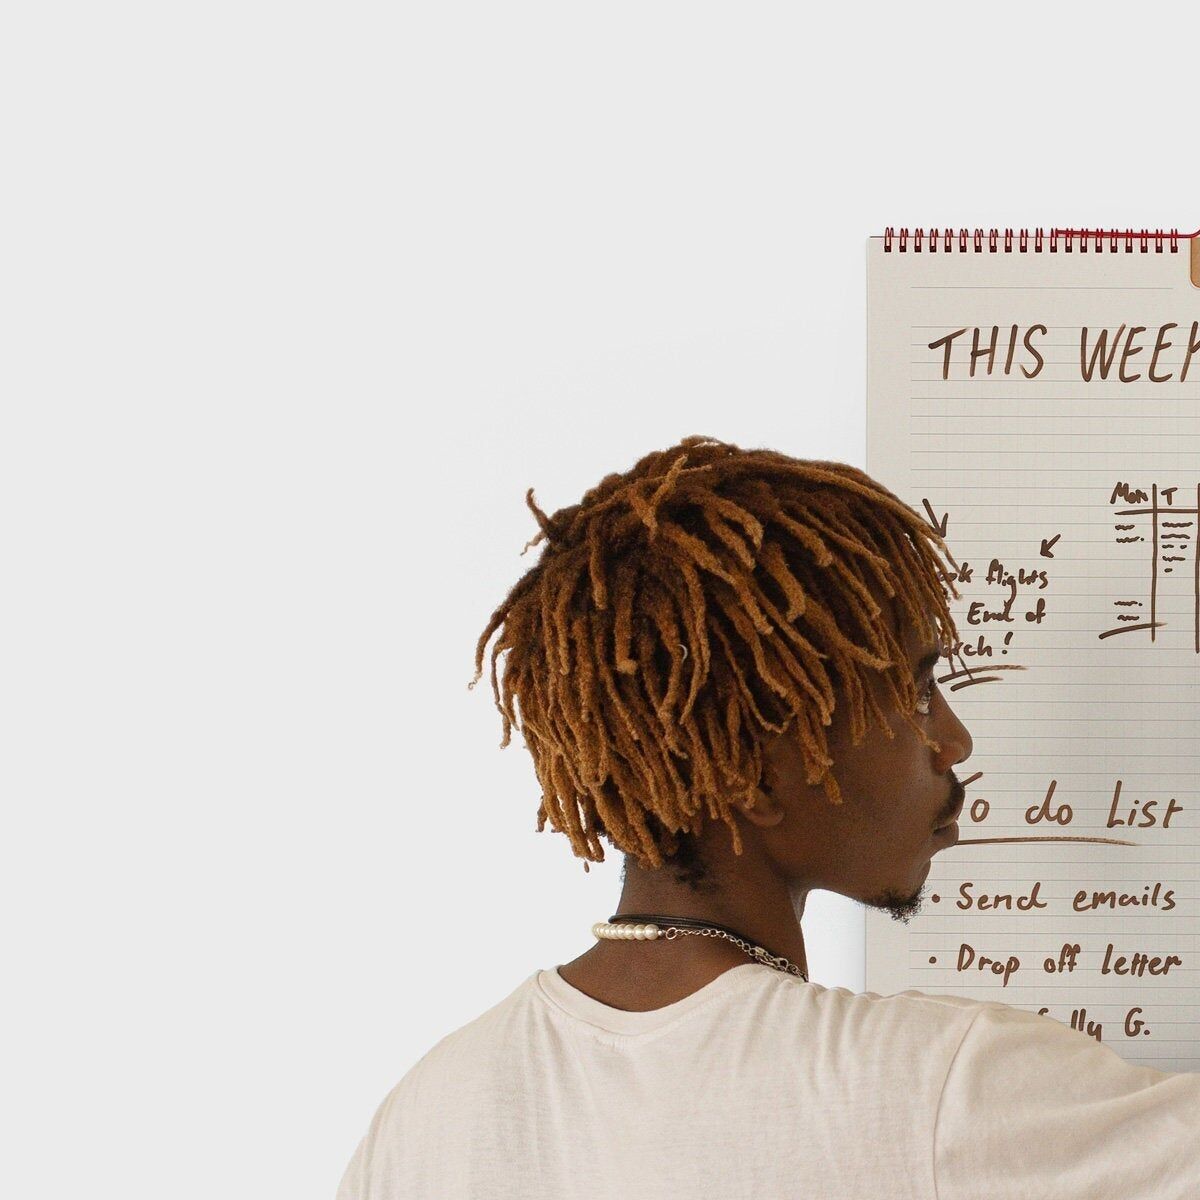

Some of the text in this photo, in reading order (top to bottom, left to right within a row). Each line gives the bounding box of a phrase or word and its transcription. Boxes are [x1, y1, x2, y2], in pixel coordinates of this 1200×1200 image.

[928, 324, 1047, 381] THIS
[1110, 482, 1148, 504] Mon
[1160, 486, 1178, 505] T
[1025, 597, 1047, 625] of
[1024, 779, 1074, 826] do
[1106, 779, 1184, 829] List
[956, 882, 1177, 912] Send emails
[956, 943, 1183, 988] Drop off letter
[1124, 1007, 1151, 1038] G.
